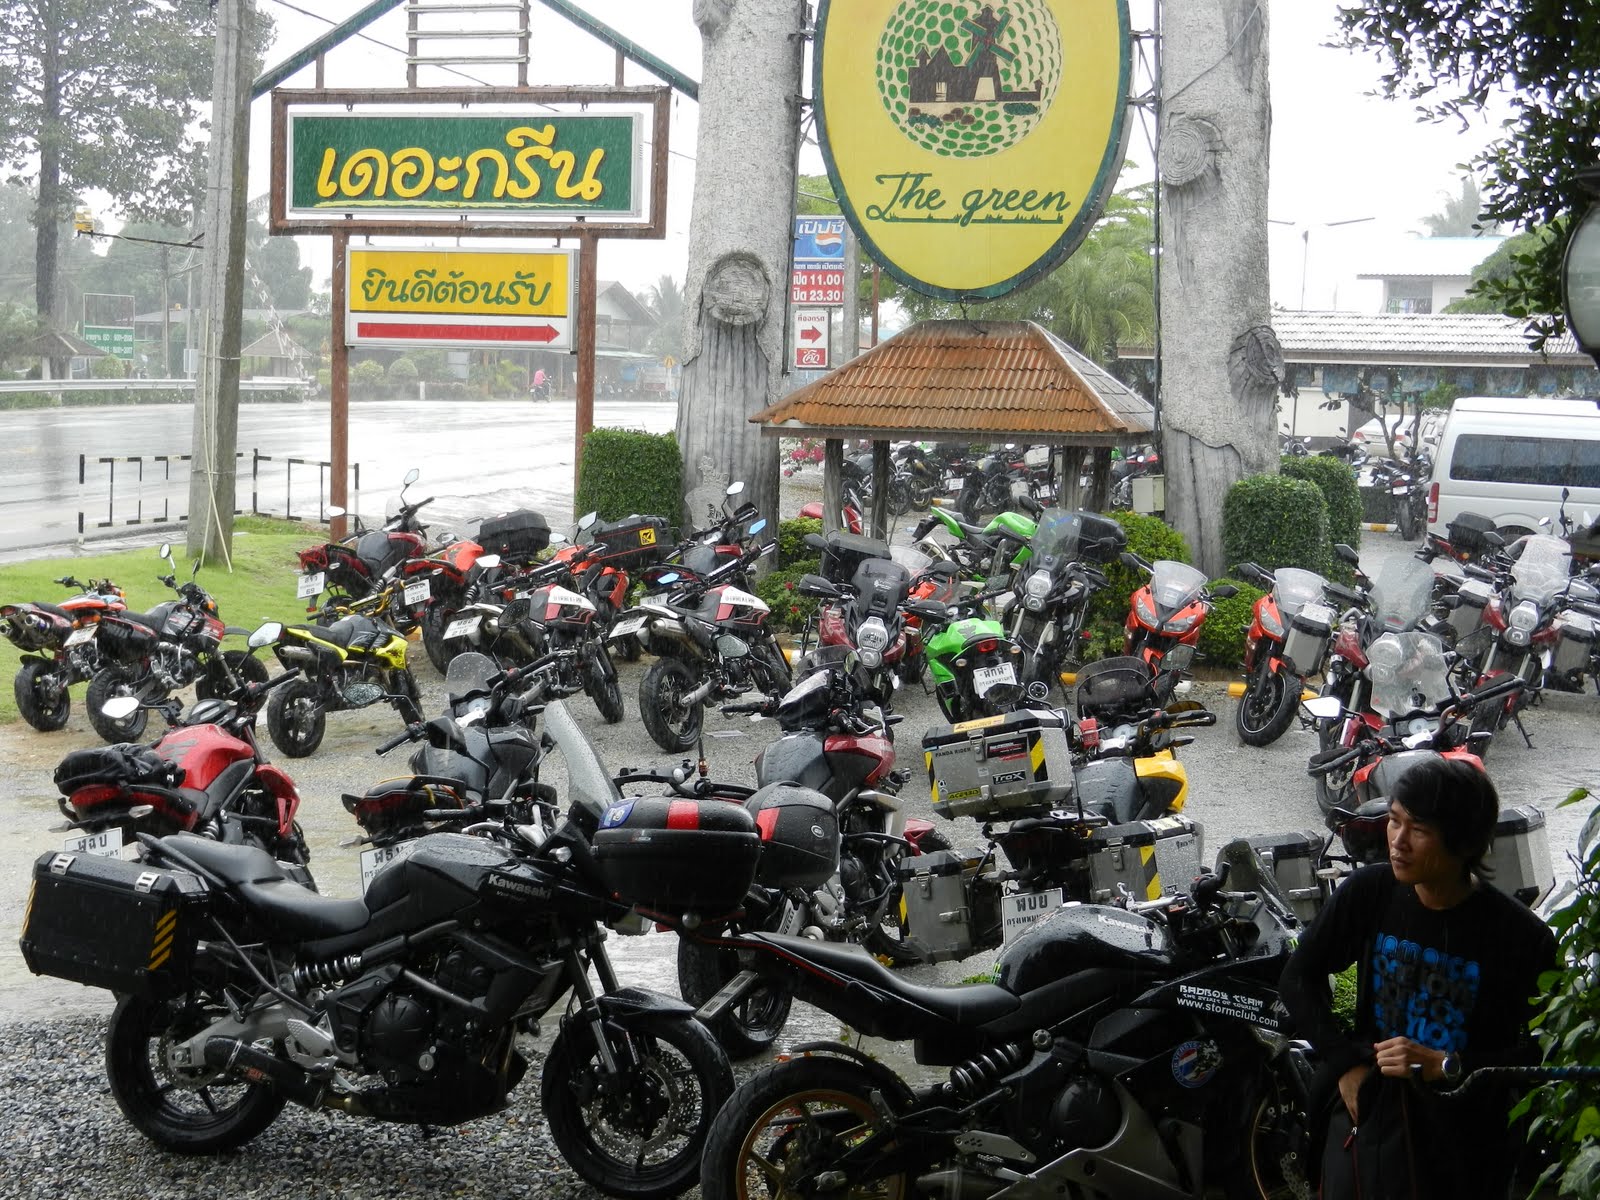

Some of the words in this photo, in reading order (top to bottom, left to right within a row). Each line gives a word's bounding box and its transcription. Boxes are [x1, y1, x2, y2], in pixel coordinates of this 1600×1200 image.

[317, 125, 604, 200] เดอะกรีน
[866, 172, 946, 221] The
[961, 188, 1071, 227] green
[361, 268, 552, 306] ยินดีต้อนรับ
[810, 274, 841, 286] 11.00
[809, 289, 841, 301] 23.30
[935, 750, 953, 758] PANDA
[993, 771, 1025, 783] TraX
[488, 873, 552, 899] Kawasaki
[1180, 985, 1228, 1000] BADBOY
[1232, 994, 1264, 1008] TEAM
[1176, 997, 1279, 1027] www.stormclub.com
